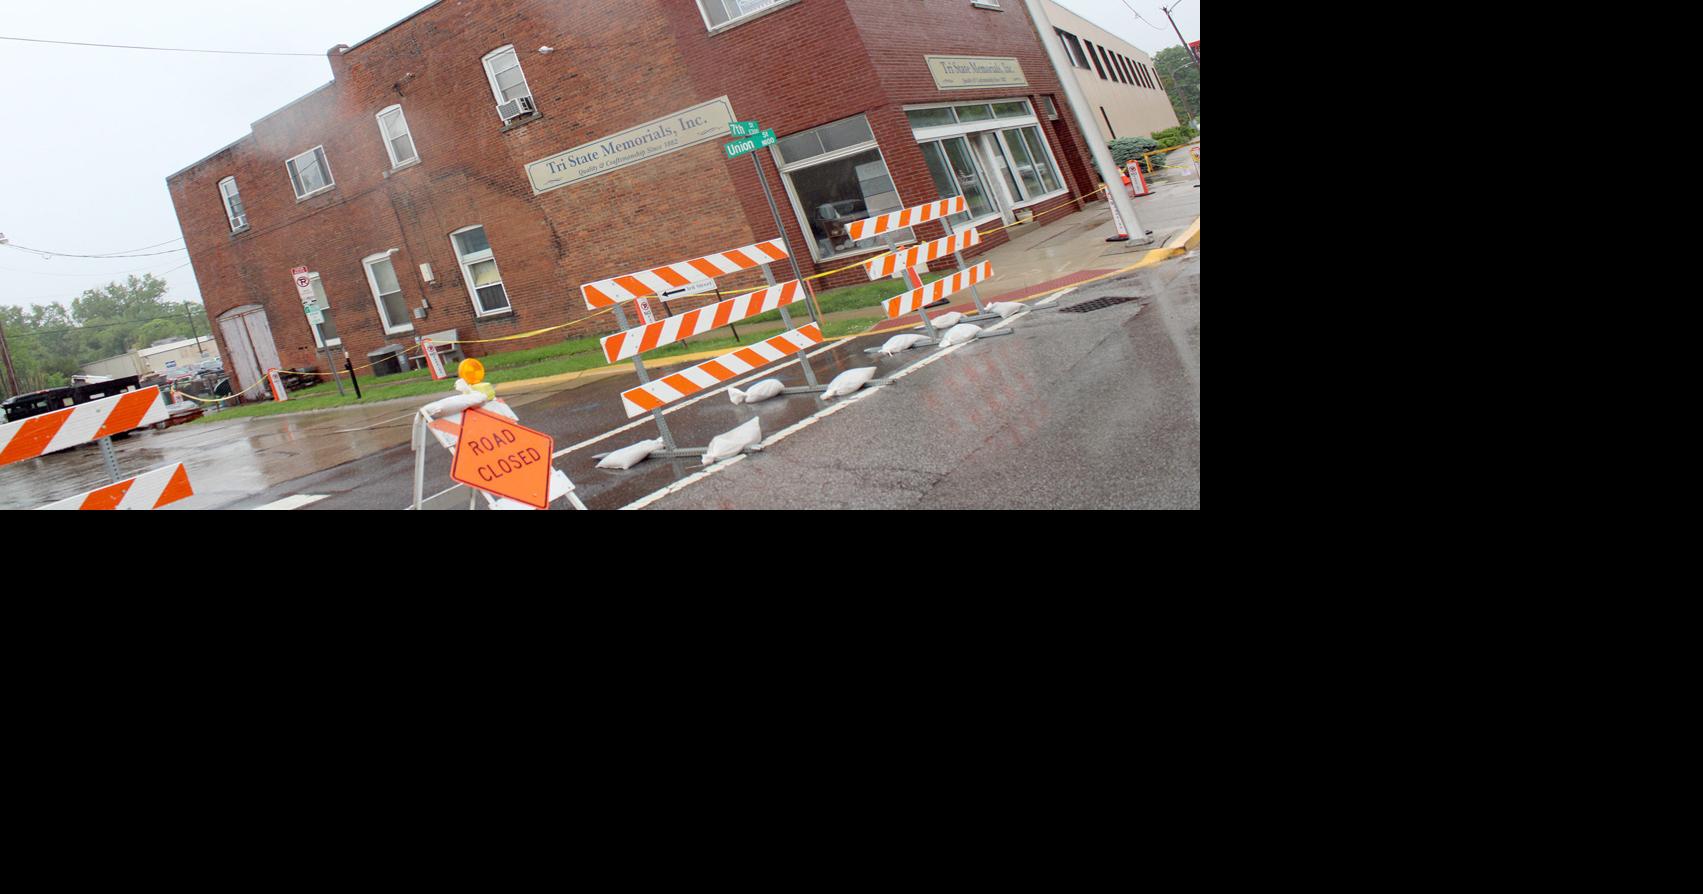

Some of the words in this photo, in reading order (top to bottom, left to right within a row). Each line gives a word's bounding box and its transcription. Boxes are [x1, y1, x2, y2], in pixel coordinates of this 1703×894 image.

[940, 61, 953, 74] Tri
[953, 62, 970, 74] State
[730, 124, 746, 136] 7th
[546, 158, 567, 174] Tri
[568, 151, 599, 168] State
[600, 125, 678, 157] Memorials,
[678, 116, 708, 131] Inc.
[727, 140, 756, 156] Union
[468, 429, 516, 456] ROAD
[477, 447, 541, 482] CLOSED
